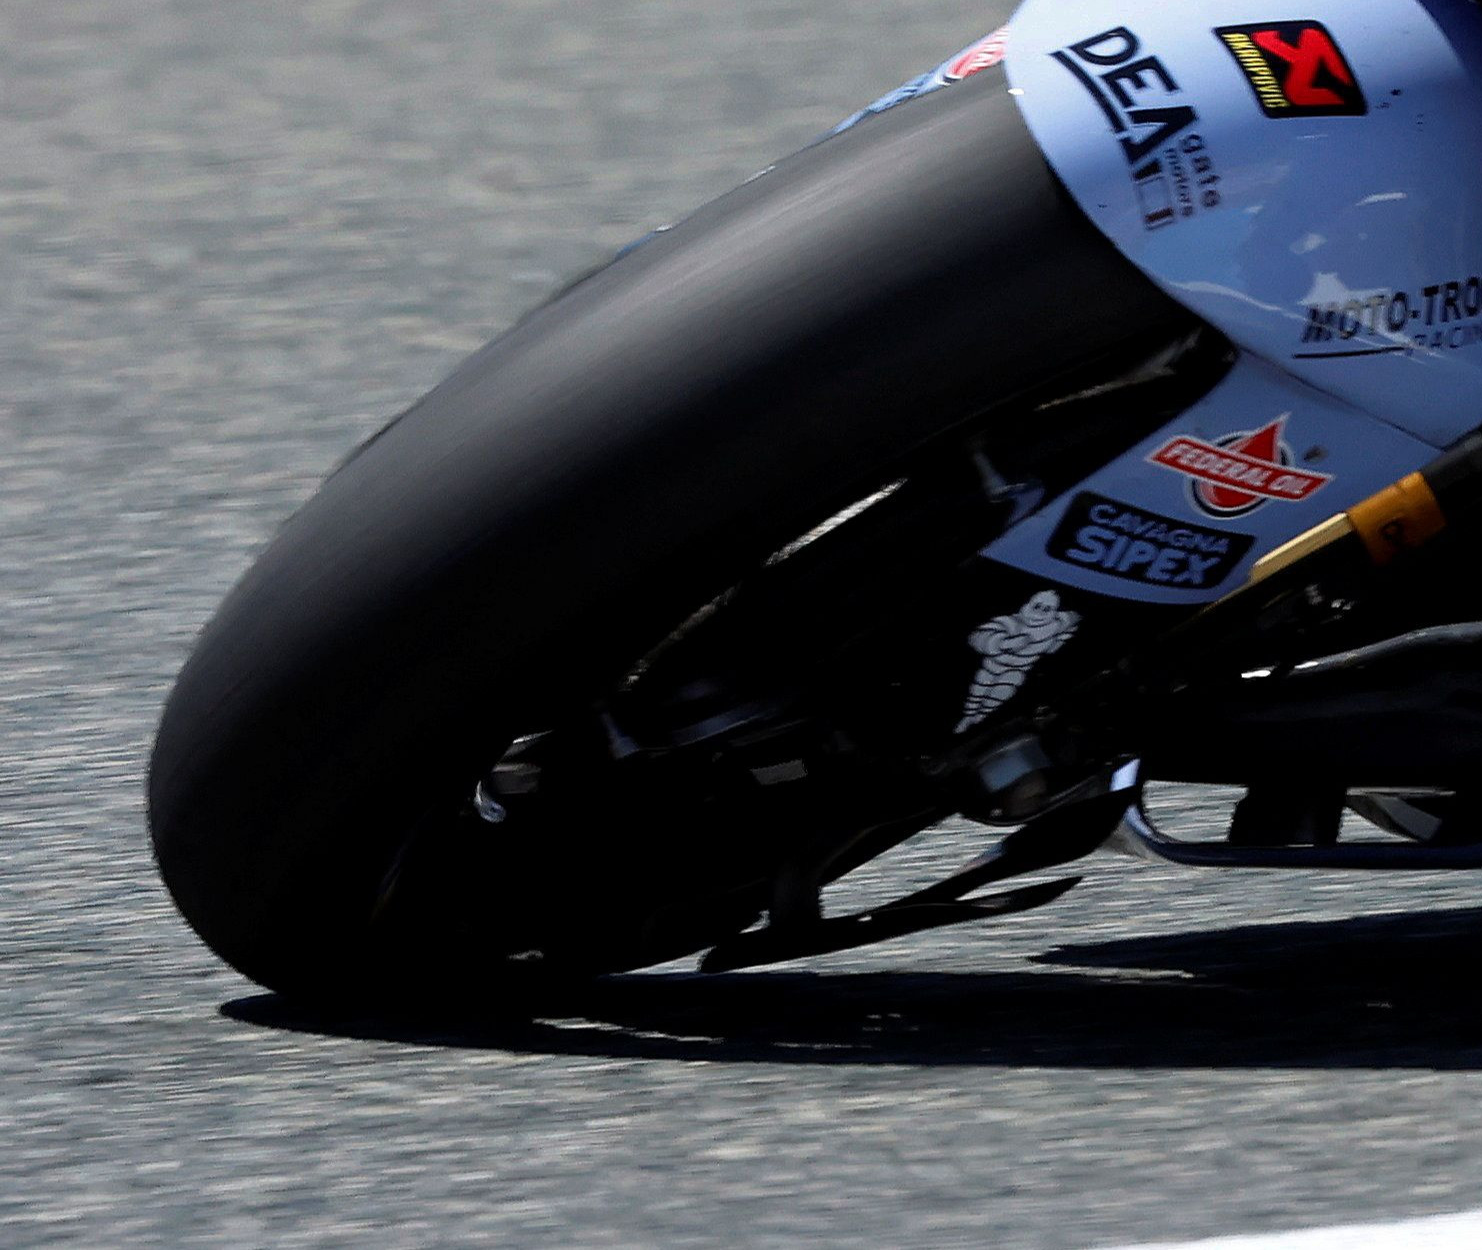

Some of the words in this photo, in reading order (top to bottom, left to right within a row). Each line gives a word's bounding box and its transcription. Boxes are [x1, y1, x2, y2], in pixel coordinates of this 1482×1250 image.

[1062, 26, 1198, 165] DEA
[1163, 443, 1273, 488] FEDERAL
[1066, 525, 1222, 585] SIPEX
